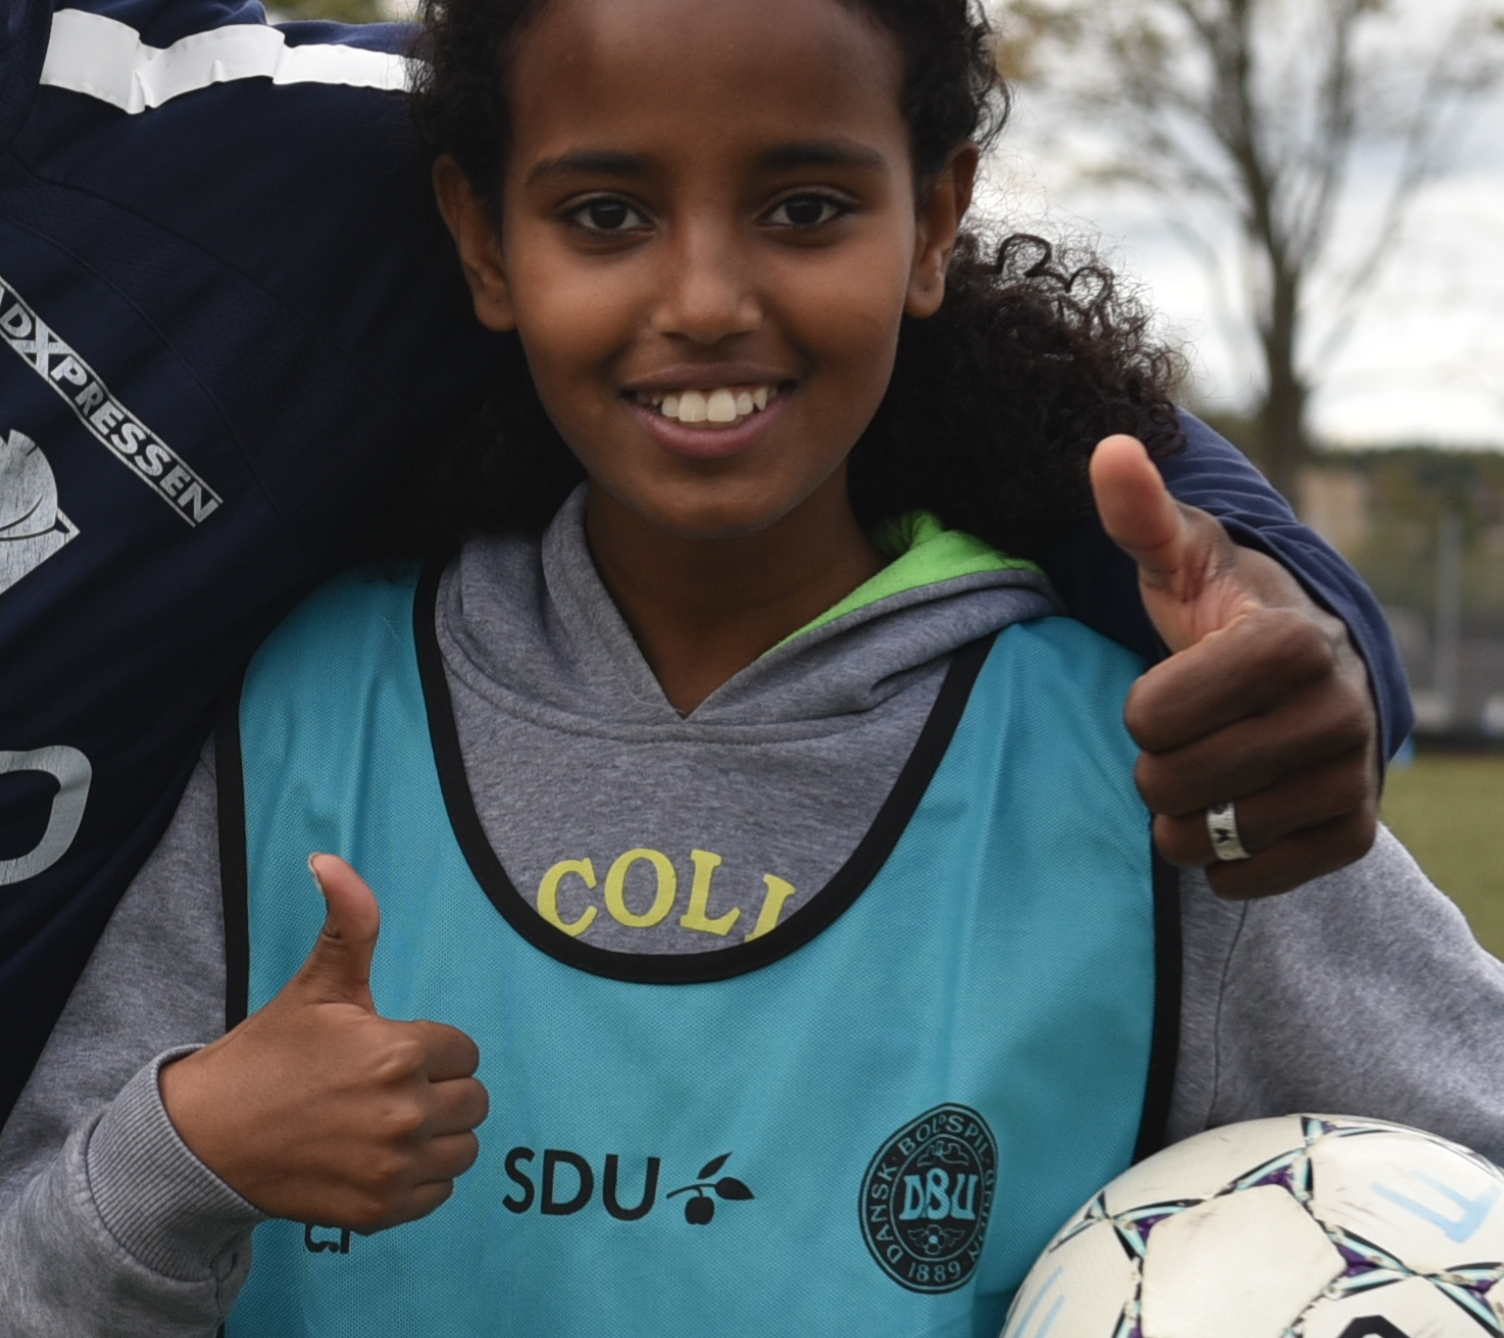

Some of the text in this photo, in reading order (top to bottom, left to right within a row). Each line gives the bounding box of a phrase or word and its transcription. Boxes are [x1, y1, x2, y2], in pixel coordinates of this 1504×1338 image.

[502, 1145, 661, 1222] SDU
[870, 1163, 903, 1263] DANSK
[899, 1168, 979, 1220] DBU
[908, 1260, 962, 1283] 1889
